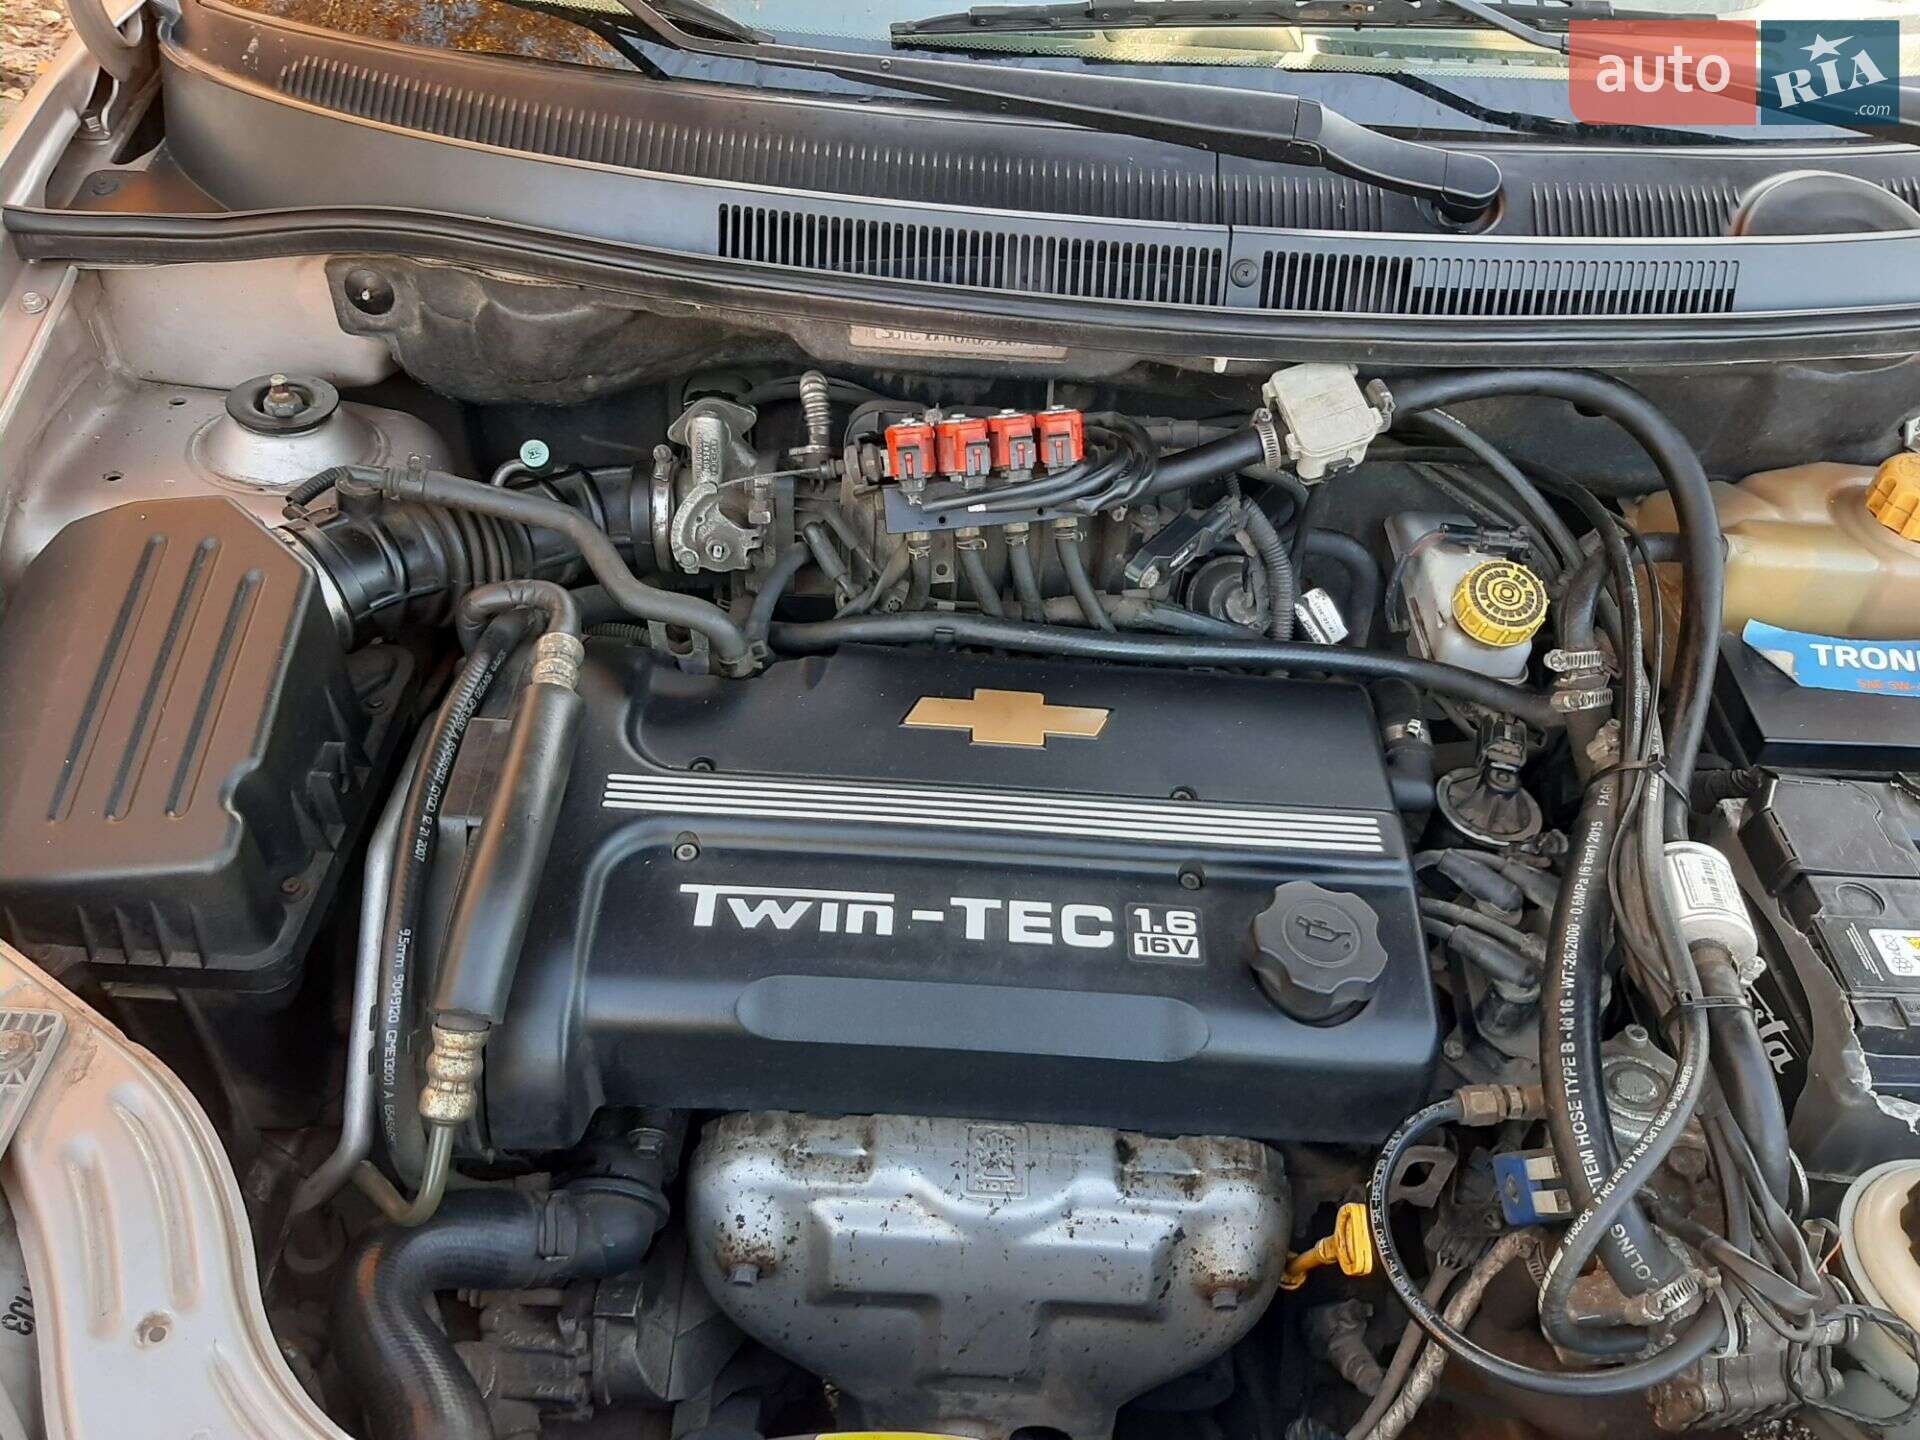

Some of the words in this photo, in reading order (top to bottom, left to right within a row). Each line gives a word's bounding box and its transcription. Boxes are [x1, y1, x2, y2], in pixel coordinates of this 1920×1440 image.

[1586, 820, 1604, 844] 2015
[413, 838, 428, 863] 2007
[1583, 844, 1600, 865] bar)
[1133, 908, 1198, 935] 1.6
[1137, 936, 1195, 957] 16V
[387, 973, 405, 1024] 9049120
[1559, 998, 1576, 1014] 16
[383, 1029, 398, 1085] GME13001
[1560, 1041, 1576, 1054] B
[1561, 1056, 1581, 1097] TYPE
[383, 1090, 395, 1099] A
[1567, 1099, 1592, 1148] HOSE
[1643, 1126, 1662, 1144] LPG
[1632, 1143, 1649, 1157] PN
[1579, 1148, 1604, 1194] TEM
[1611, 1167, 1628, 1184] bar
[1594, 1196, 1603, 1205] 4
[1599, 1182, 1616, 1199] DN
[1609, 1222, 1660, 1284] OLING
